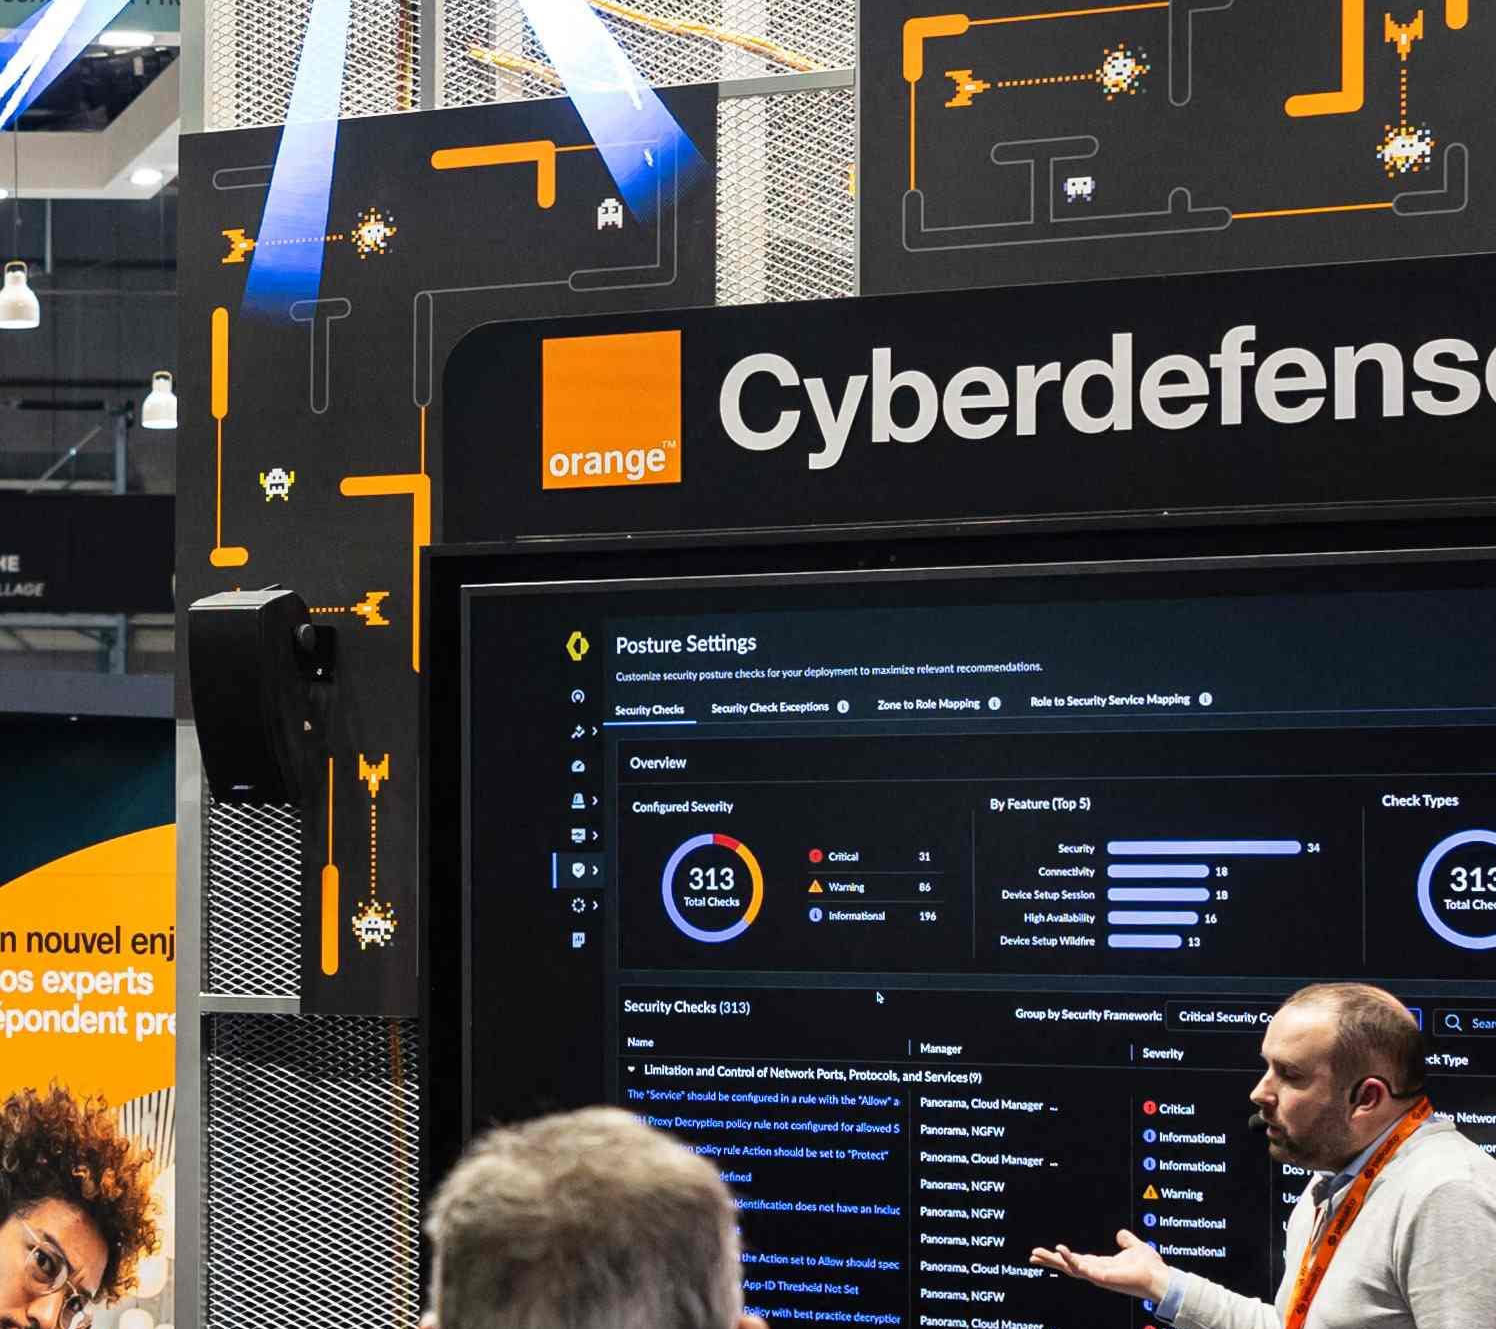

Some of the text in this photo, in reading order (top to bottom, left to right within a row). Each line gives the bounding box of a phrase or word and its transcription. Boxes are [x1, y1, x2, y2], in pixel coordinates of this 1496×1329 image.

[616, 633, 757, 655] Posture Settings
[615, 661, 1043, 682] Customize security posture checks for your deployment to maximize relevant recommendations.
[877, 697, 981, 711] Zone to Role Mapping
[1030, 693, 1191, 708] Role to Security Service Mapping
[615, 704, 685, 717] Security Checks
[711, 701, 830, 715] Security Check Exceptions
[629, 755, 687, 770] Overview
[632, 800, 734, 815] Configured Severity
[989, 796, 1092, 812] By Feature (Top 5)
[1381, 793, 1460, 809] Check Types
[1057, 842, 1321, 855] Security 34
[828, 851, 931, 862] Critical 31
[688, 867, 735, 891] 313
[1038, 866, 1096, 878] Connectivity
[828, 882, 865, 894] Warning
[683, 896, 741, 908] Total Checks
[1001, 889, 1033, 900] Device
[1033, 889, 1061, 902] Setup
[1061, 889, 1096, 900] Session
[1443, 898, 1471, 910] Total
[828, 910, 937, 922] Informational 196
[1023, 912, 1046, 925] High
[1045, 912, 1096, 925] Availability
[26, 925, 121, 955] nouvel
[130, 925, 175, 962] enj
[1000, 935, 1201, 948] Device Setup Wildfire 13
[41, 966, 155, 1001] experts
[624, 999, 751, 1016] Security Checks (313)
[627, 1037, 655, 1048] Name
[920, 1042, 963, 1056] Manager
[1142, 1047, 1185, 1061] Severity
